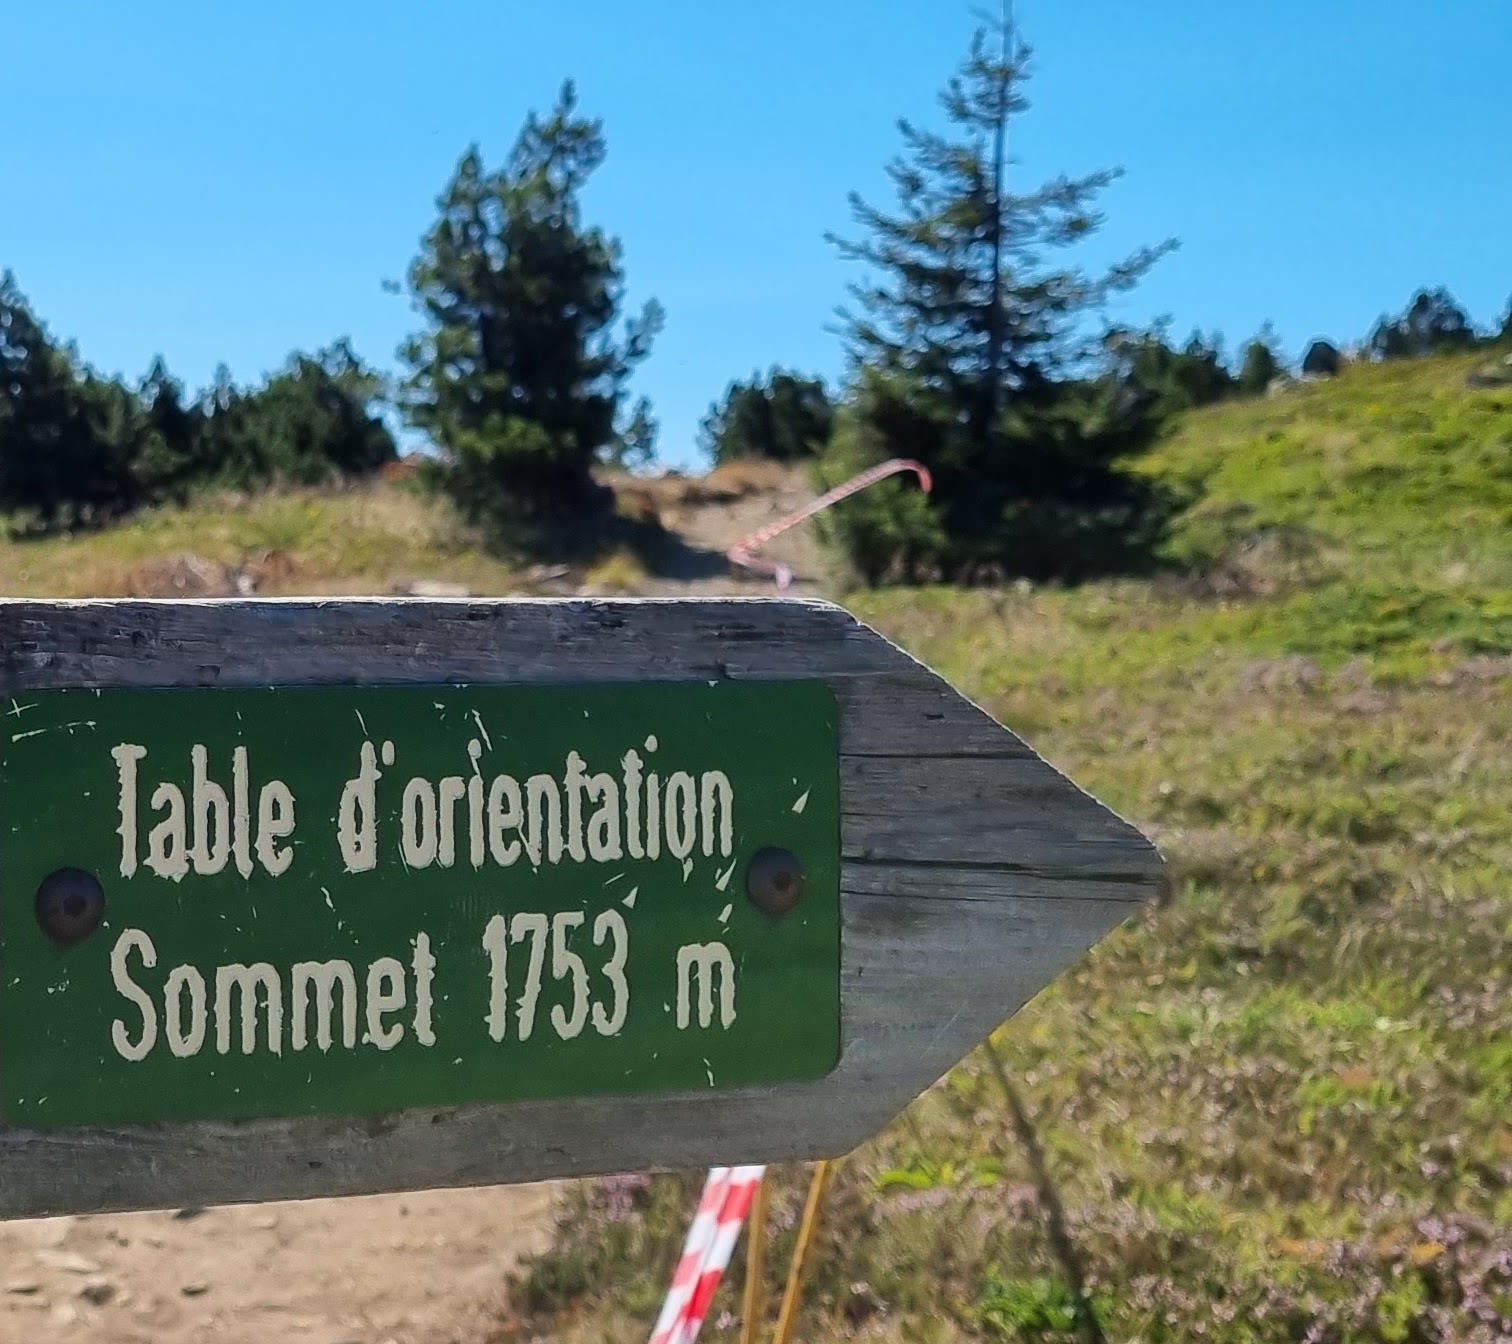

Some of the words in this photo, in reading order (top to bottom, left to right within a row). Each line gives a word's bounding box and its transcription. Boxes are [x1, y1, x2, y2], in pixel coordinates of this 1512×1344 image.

[109, 742, 296, 880] Table
[337, 736, 735, 873] d'orientation
[109, 928, 437, 1062] Sommet
[482, 909, 630, 1043] 1753
[675, 940, 738, 1031] m
